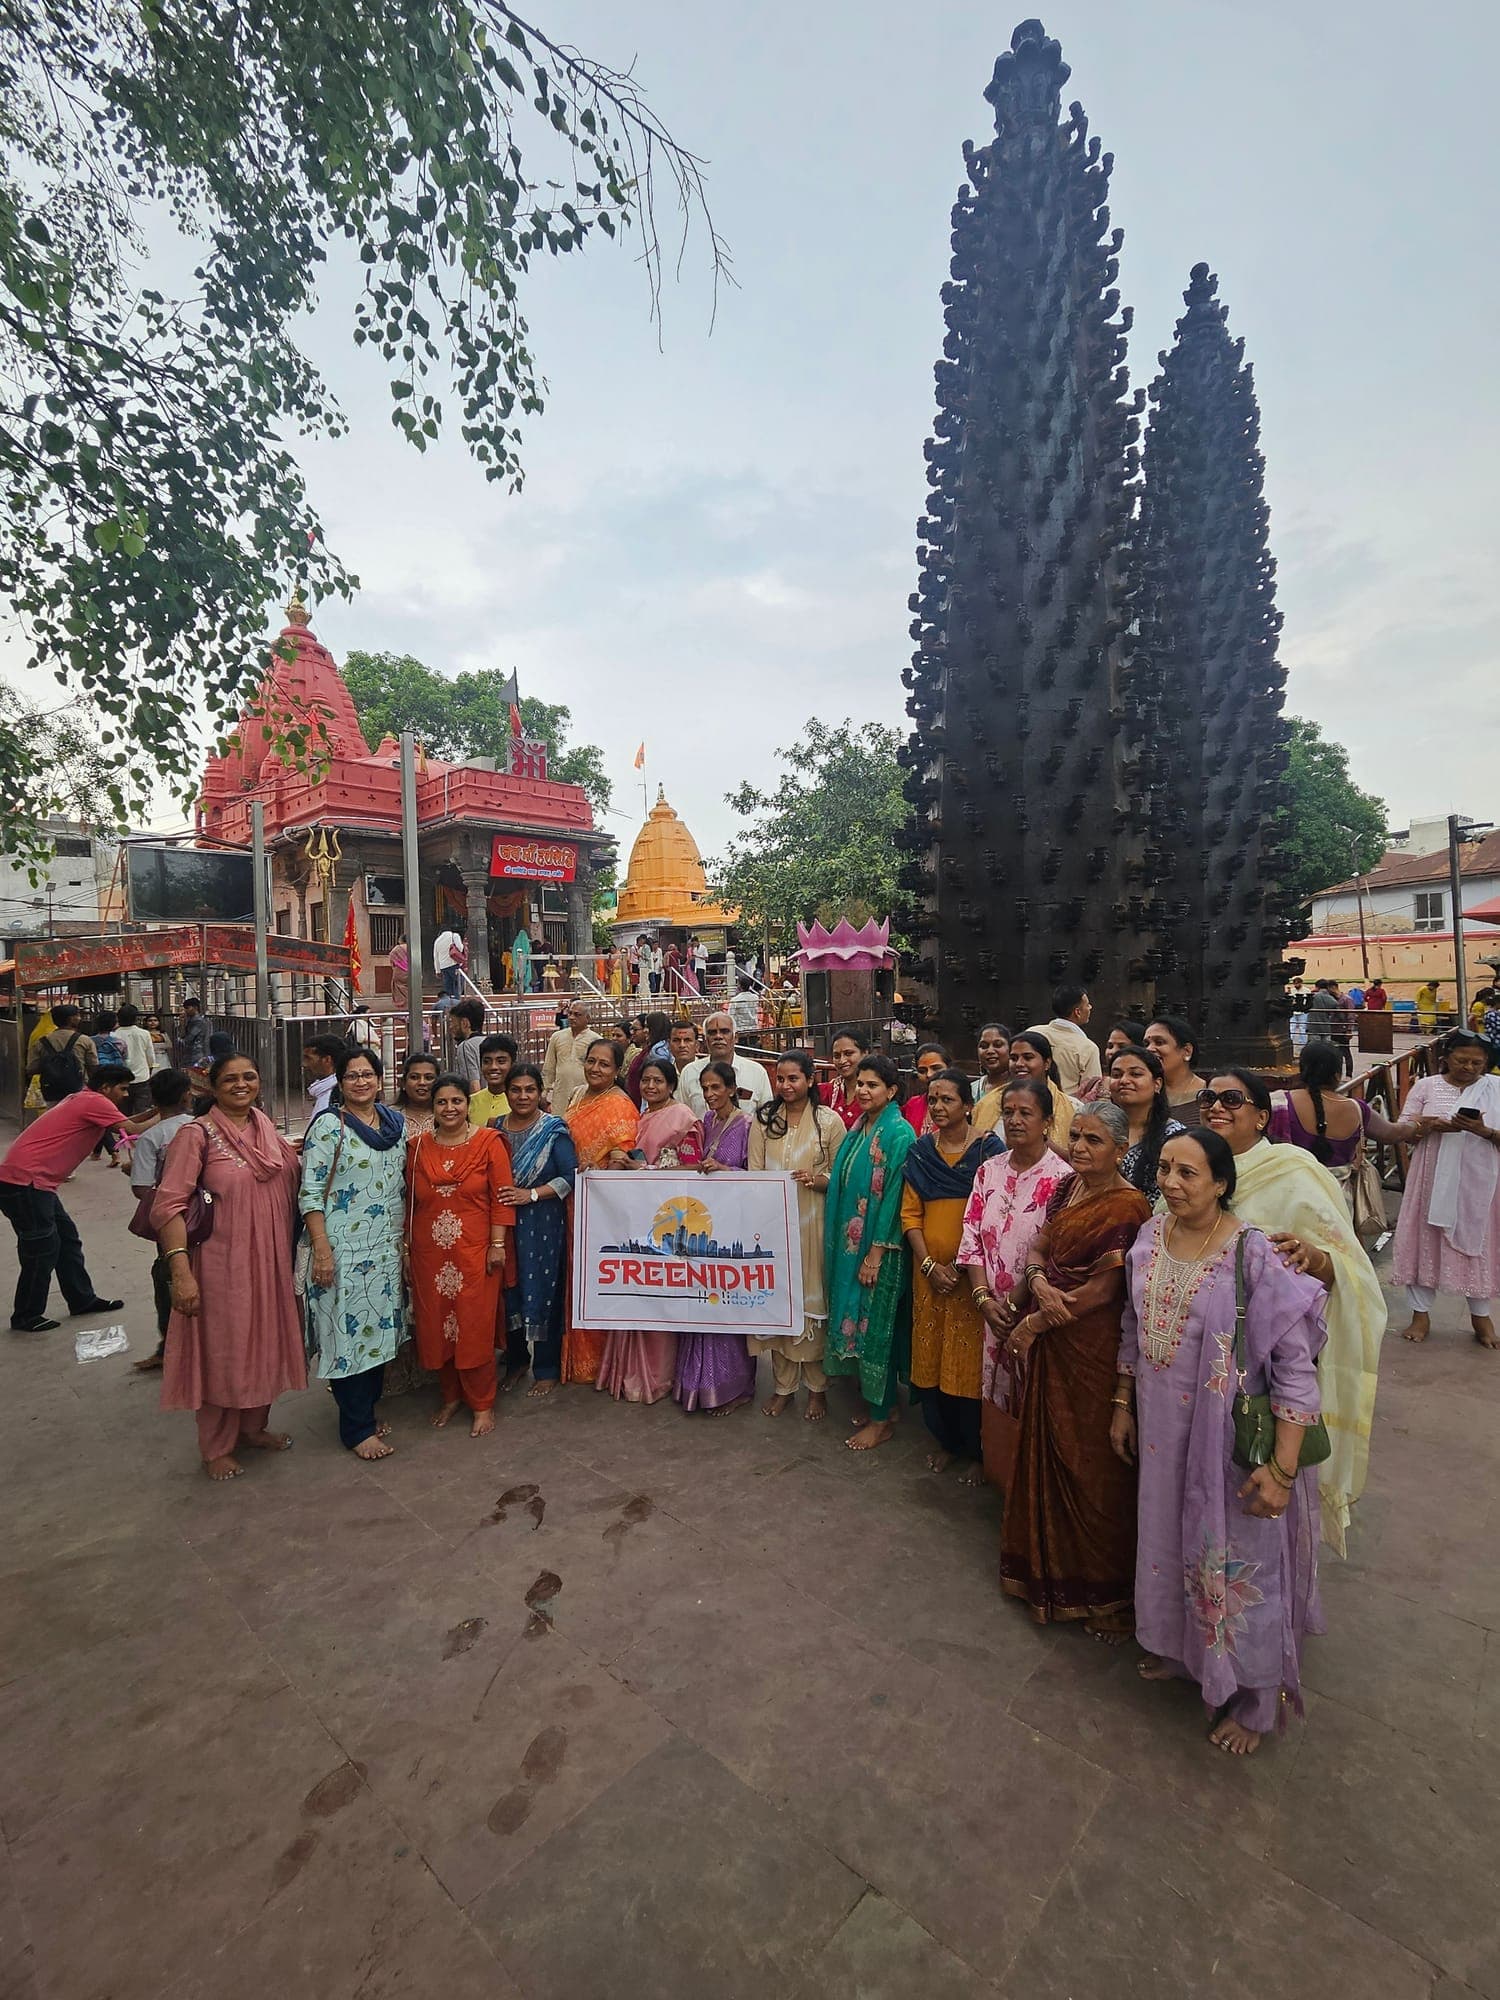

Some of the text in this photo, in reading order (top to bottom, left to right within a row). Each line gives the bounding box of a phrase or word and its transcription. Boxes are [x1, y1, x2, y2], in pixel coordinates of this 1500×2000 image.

[498, 845, 521, 862] जय
[521, 843, 538, 863] माँ
[598, 1260, 775, 1291] SREENIDHI
